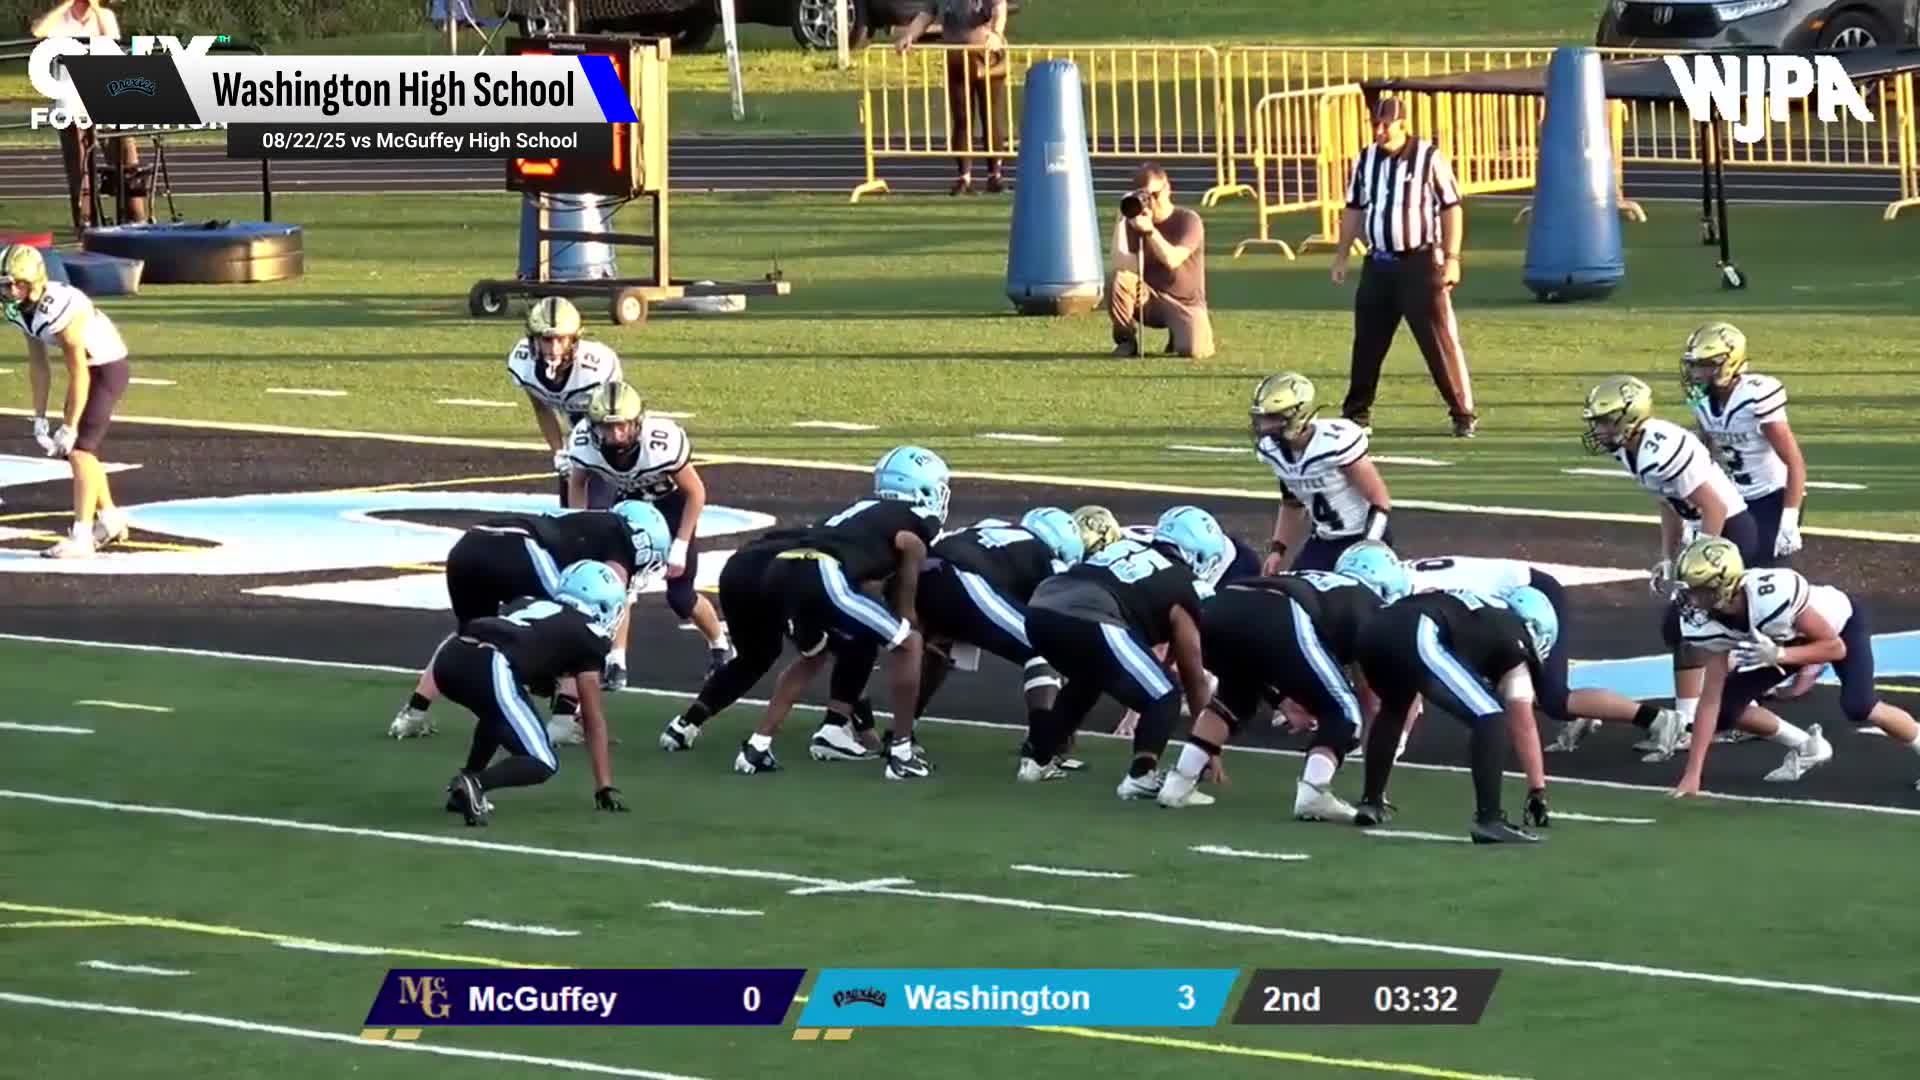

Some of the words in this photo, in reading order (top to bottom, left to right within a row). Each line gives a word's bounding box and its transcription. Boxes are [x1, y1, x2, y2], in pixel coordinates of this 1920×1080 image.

[581, 352, 601, 372] 12
[649, 429, 670, 451] 30
[1323, 423, 1346, 440] 14
[1643, 431, 1668, 454] 34
[1757, 573, 1776, 597] 84
